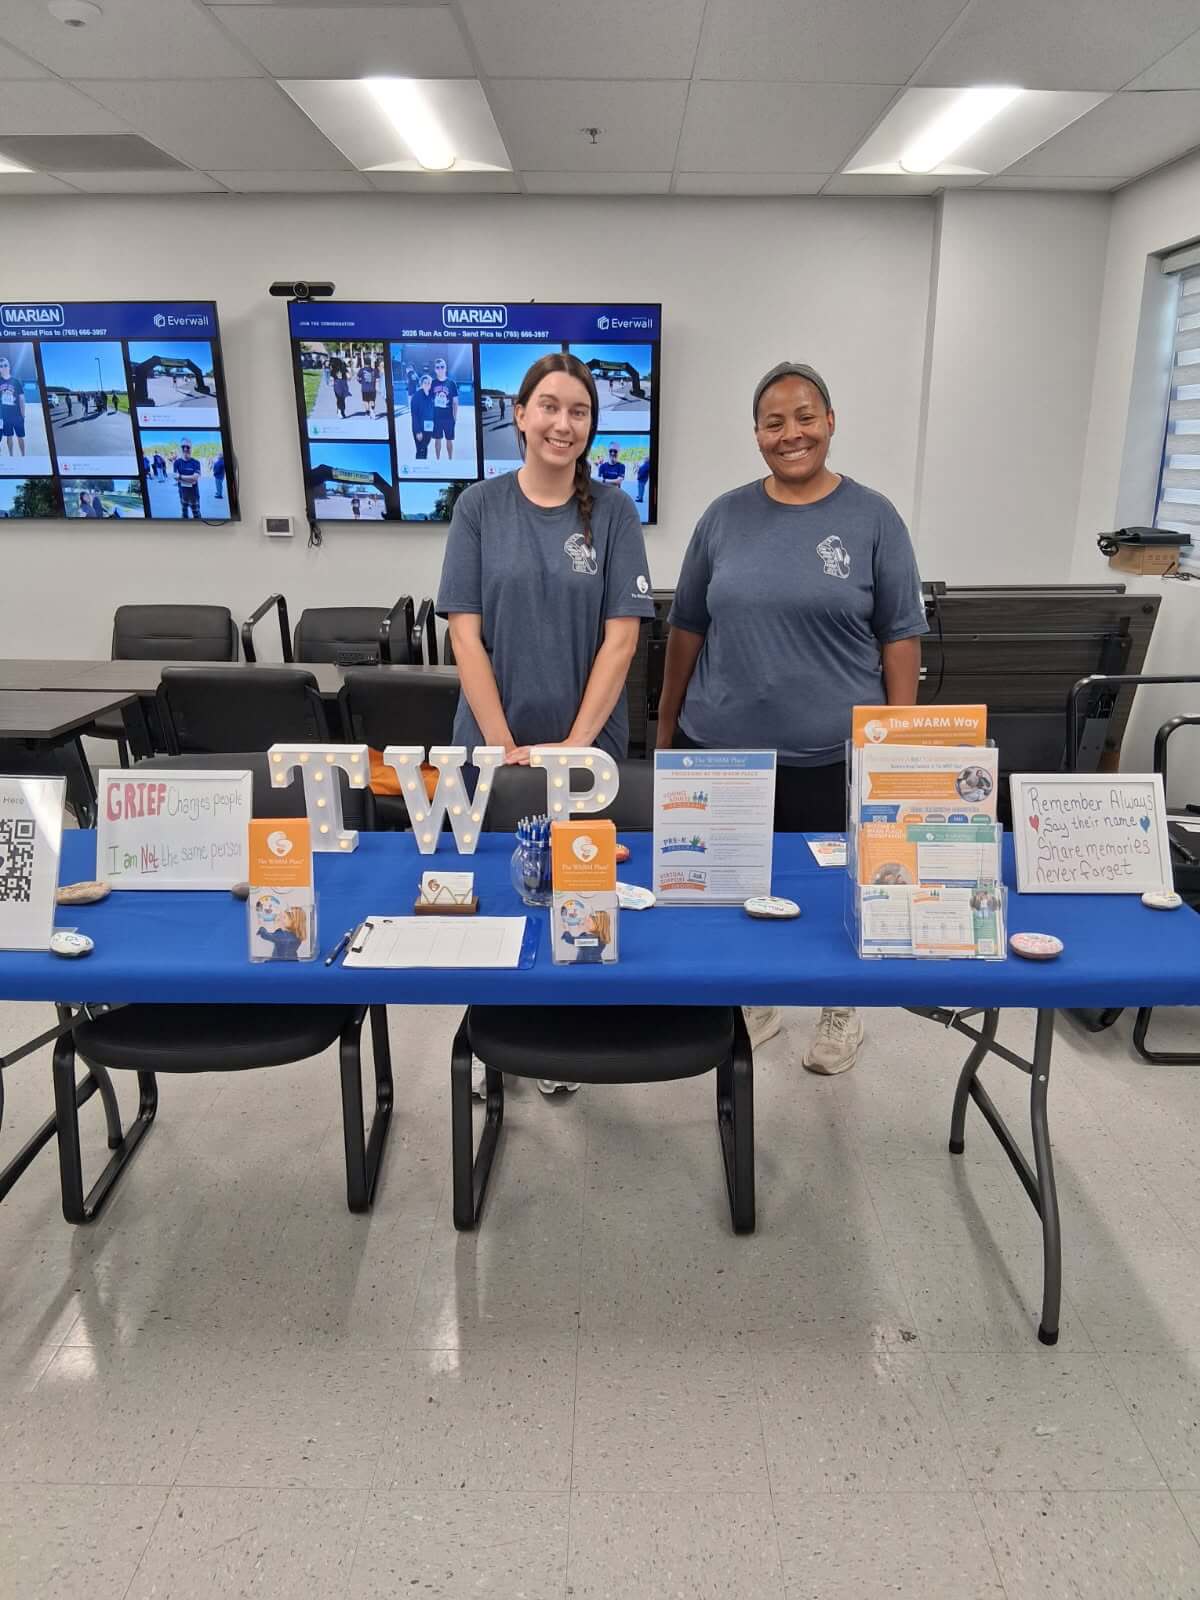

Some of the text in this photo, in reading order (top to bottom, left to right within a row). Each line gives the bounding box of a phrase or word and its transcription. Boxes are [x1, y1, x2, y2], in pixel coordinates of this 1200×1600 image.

[5, 309, 60, 323] MARIAN
[168, 315, 208, 326] Everwall
[447, 309, 503, 323] MARIAN
[612, 318, 652, 329] Everwall
[890, 717, 979, 730] The WARM Way
[107, 783, 242, 821] GRIEF Changes people
[1028, 787, 1153, 814] Remember Always
[1043, 816, 1137, 838] Say their name
[1038, 836, 1151, 862] Share memories
[108, 845, 121, 875] I
[124, 853, 137, 869] am
[141, 844, 160, 871] Not
[161, 844, 179, 867] the
[182, 846, 208, 861] same
